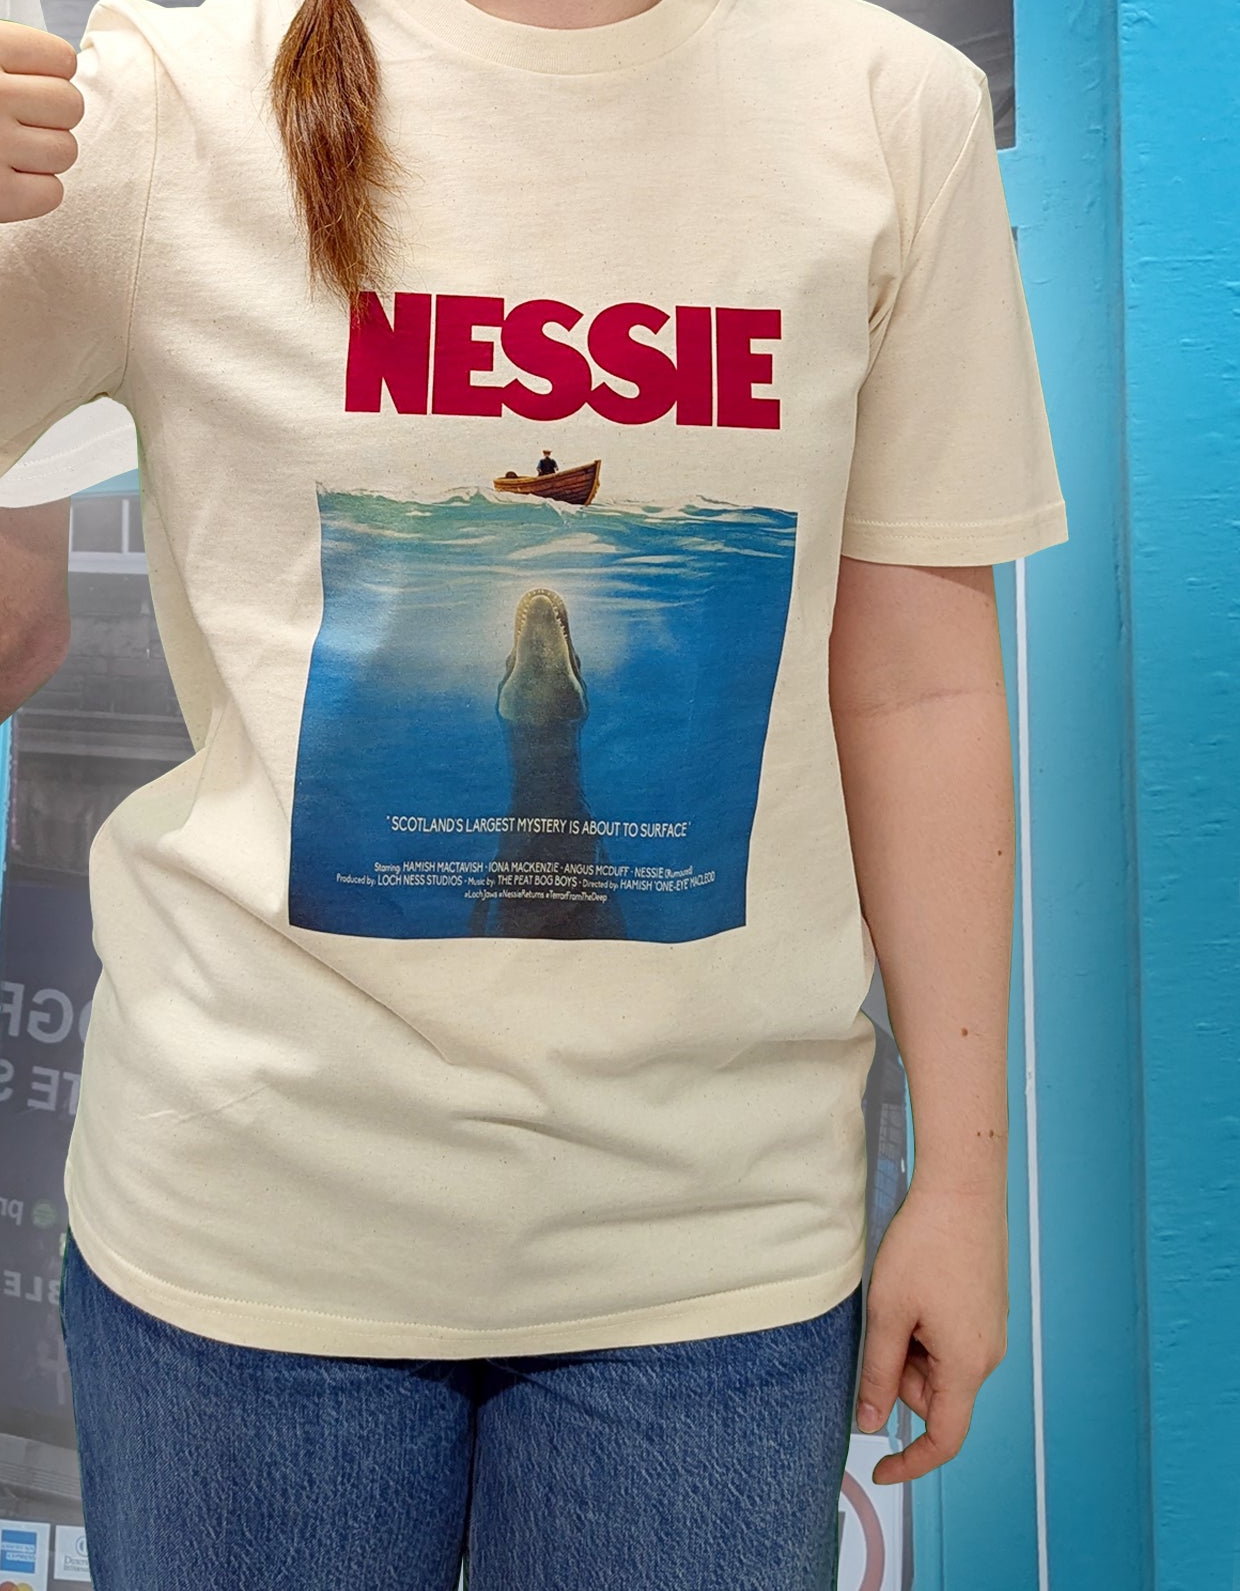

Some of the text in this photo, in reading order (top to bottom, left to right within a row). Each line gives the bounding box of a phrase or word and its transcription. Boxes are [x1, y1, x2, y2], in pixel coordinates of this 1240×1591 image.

[345, 291, 782, 430] NESSIE
[466, 817, 515, 833] LARGEST
[517, 818, 567, 834] MYSTERY
[569, 820, 580, 835] IS
[581, 820, 620, 837] ABOUT
[623, 822, 638, 838] TO
[402, 861, 436, 873] HAMISH
[437, 861, 484, 873] MACTAVISH
[488, 861, 509, 873] IONA
[511, 861, 560, 874] MACKENZIE
[563, 863, 594, 876] ANGUS
[595, 864, 630, 877] MCDUFF
[634, 866, 664, 879] NESSIE
[336, 873, 366, 886] Produced
[378, 874, 402, 886] LOCH
[403, 874, 425, 886] NESS
[426, 874, 463, 886] STUDIOS
[497, 874, 513, 886] THE
[513, 874, 533, 886] PEAT
[534, 874, 554, 886] BOG
[555, 875, 578, 888] BOYS
[582, 878, 611, 889] Directed
[620, 878, 652, 891] HAMISH
